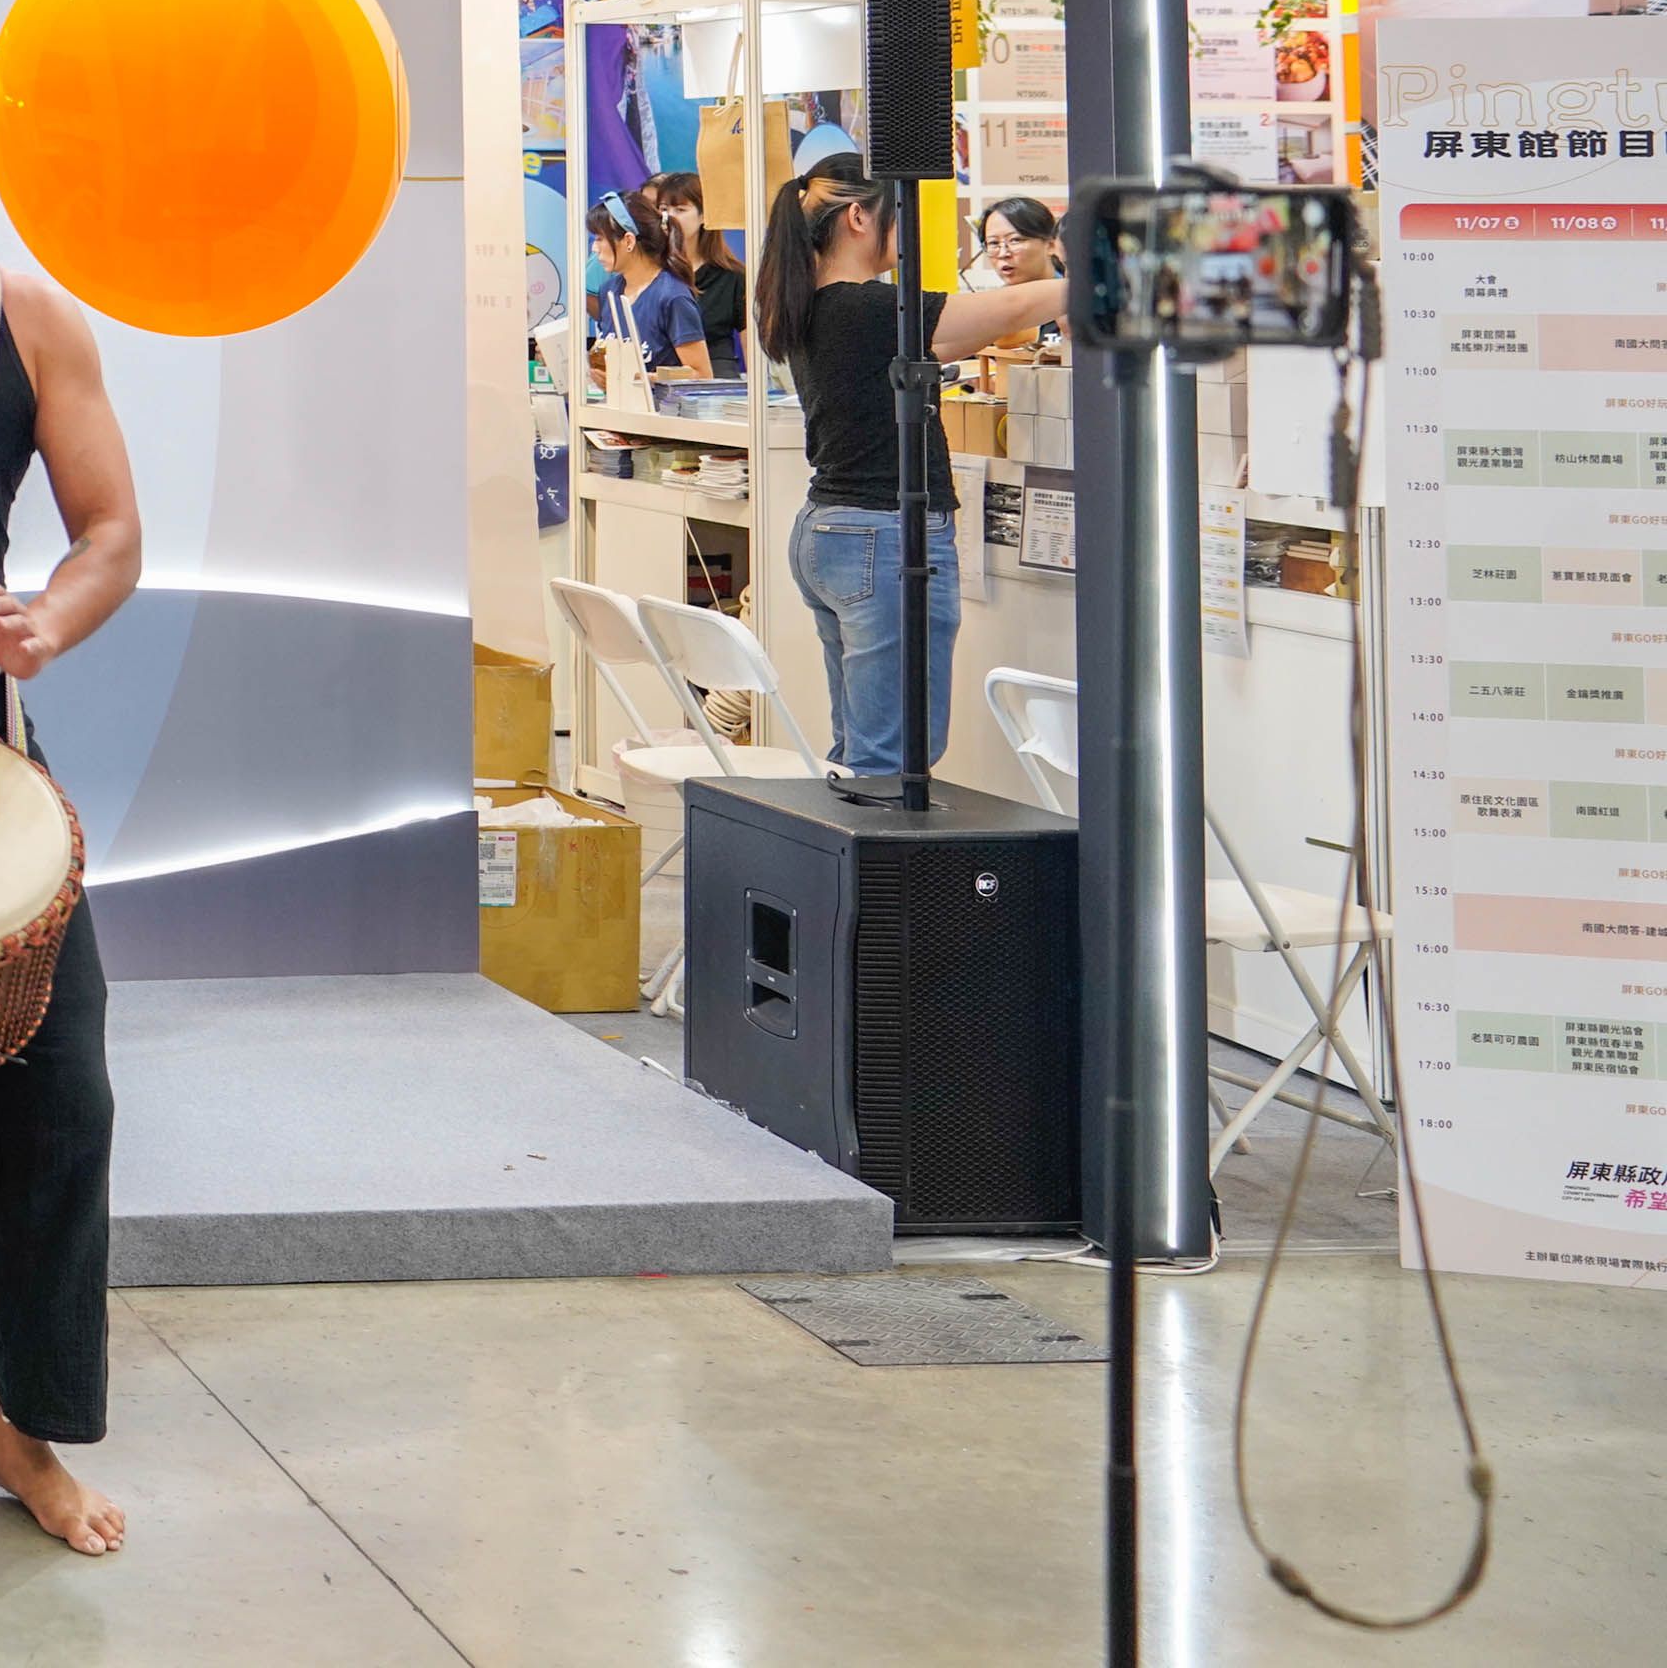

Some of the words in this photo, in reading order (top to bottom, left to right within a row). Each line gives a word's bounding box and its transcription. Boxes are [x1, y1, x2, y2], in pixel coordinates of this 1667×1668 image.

[1424, 129, 1667, 158] 屏東館節目
[1455, 216, 1500, 230] 11/07
[1551, 216, 1598, 230] 11/08
[1402, 252, 1434, 262] 10:00
[1475, 275, 1497, 285] 大會
[1404, 310, 1436, 319] 10:30
[1405, 367, 1437, 376] 11:00
[1406, 424, 1438, 433] 11:30
[1407, 482, 1439, 491] 12:00
[1408, 539, 1441, 549] 12:30
[1409, 597, 1442, 606] 13:00
[1410, 655, 1443, 664] 13:30
[1412, 713, 1444, 722] 14:00
[1413, 770, 1445, 780] 14:30
[1414, 828, 1447, 838] 15:00
[1415, 886, 1448, 896] 15:30
[1416, 944, 1449, 954] 16:00
[1417, 1002, 1450, 1012] 16:30
[1418, 1060, 1451, 1070] 17:00
[1420, 1118, 1453, 1129] 18:00
